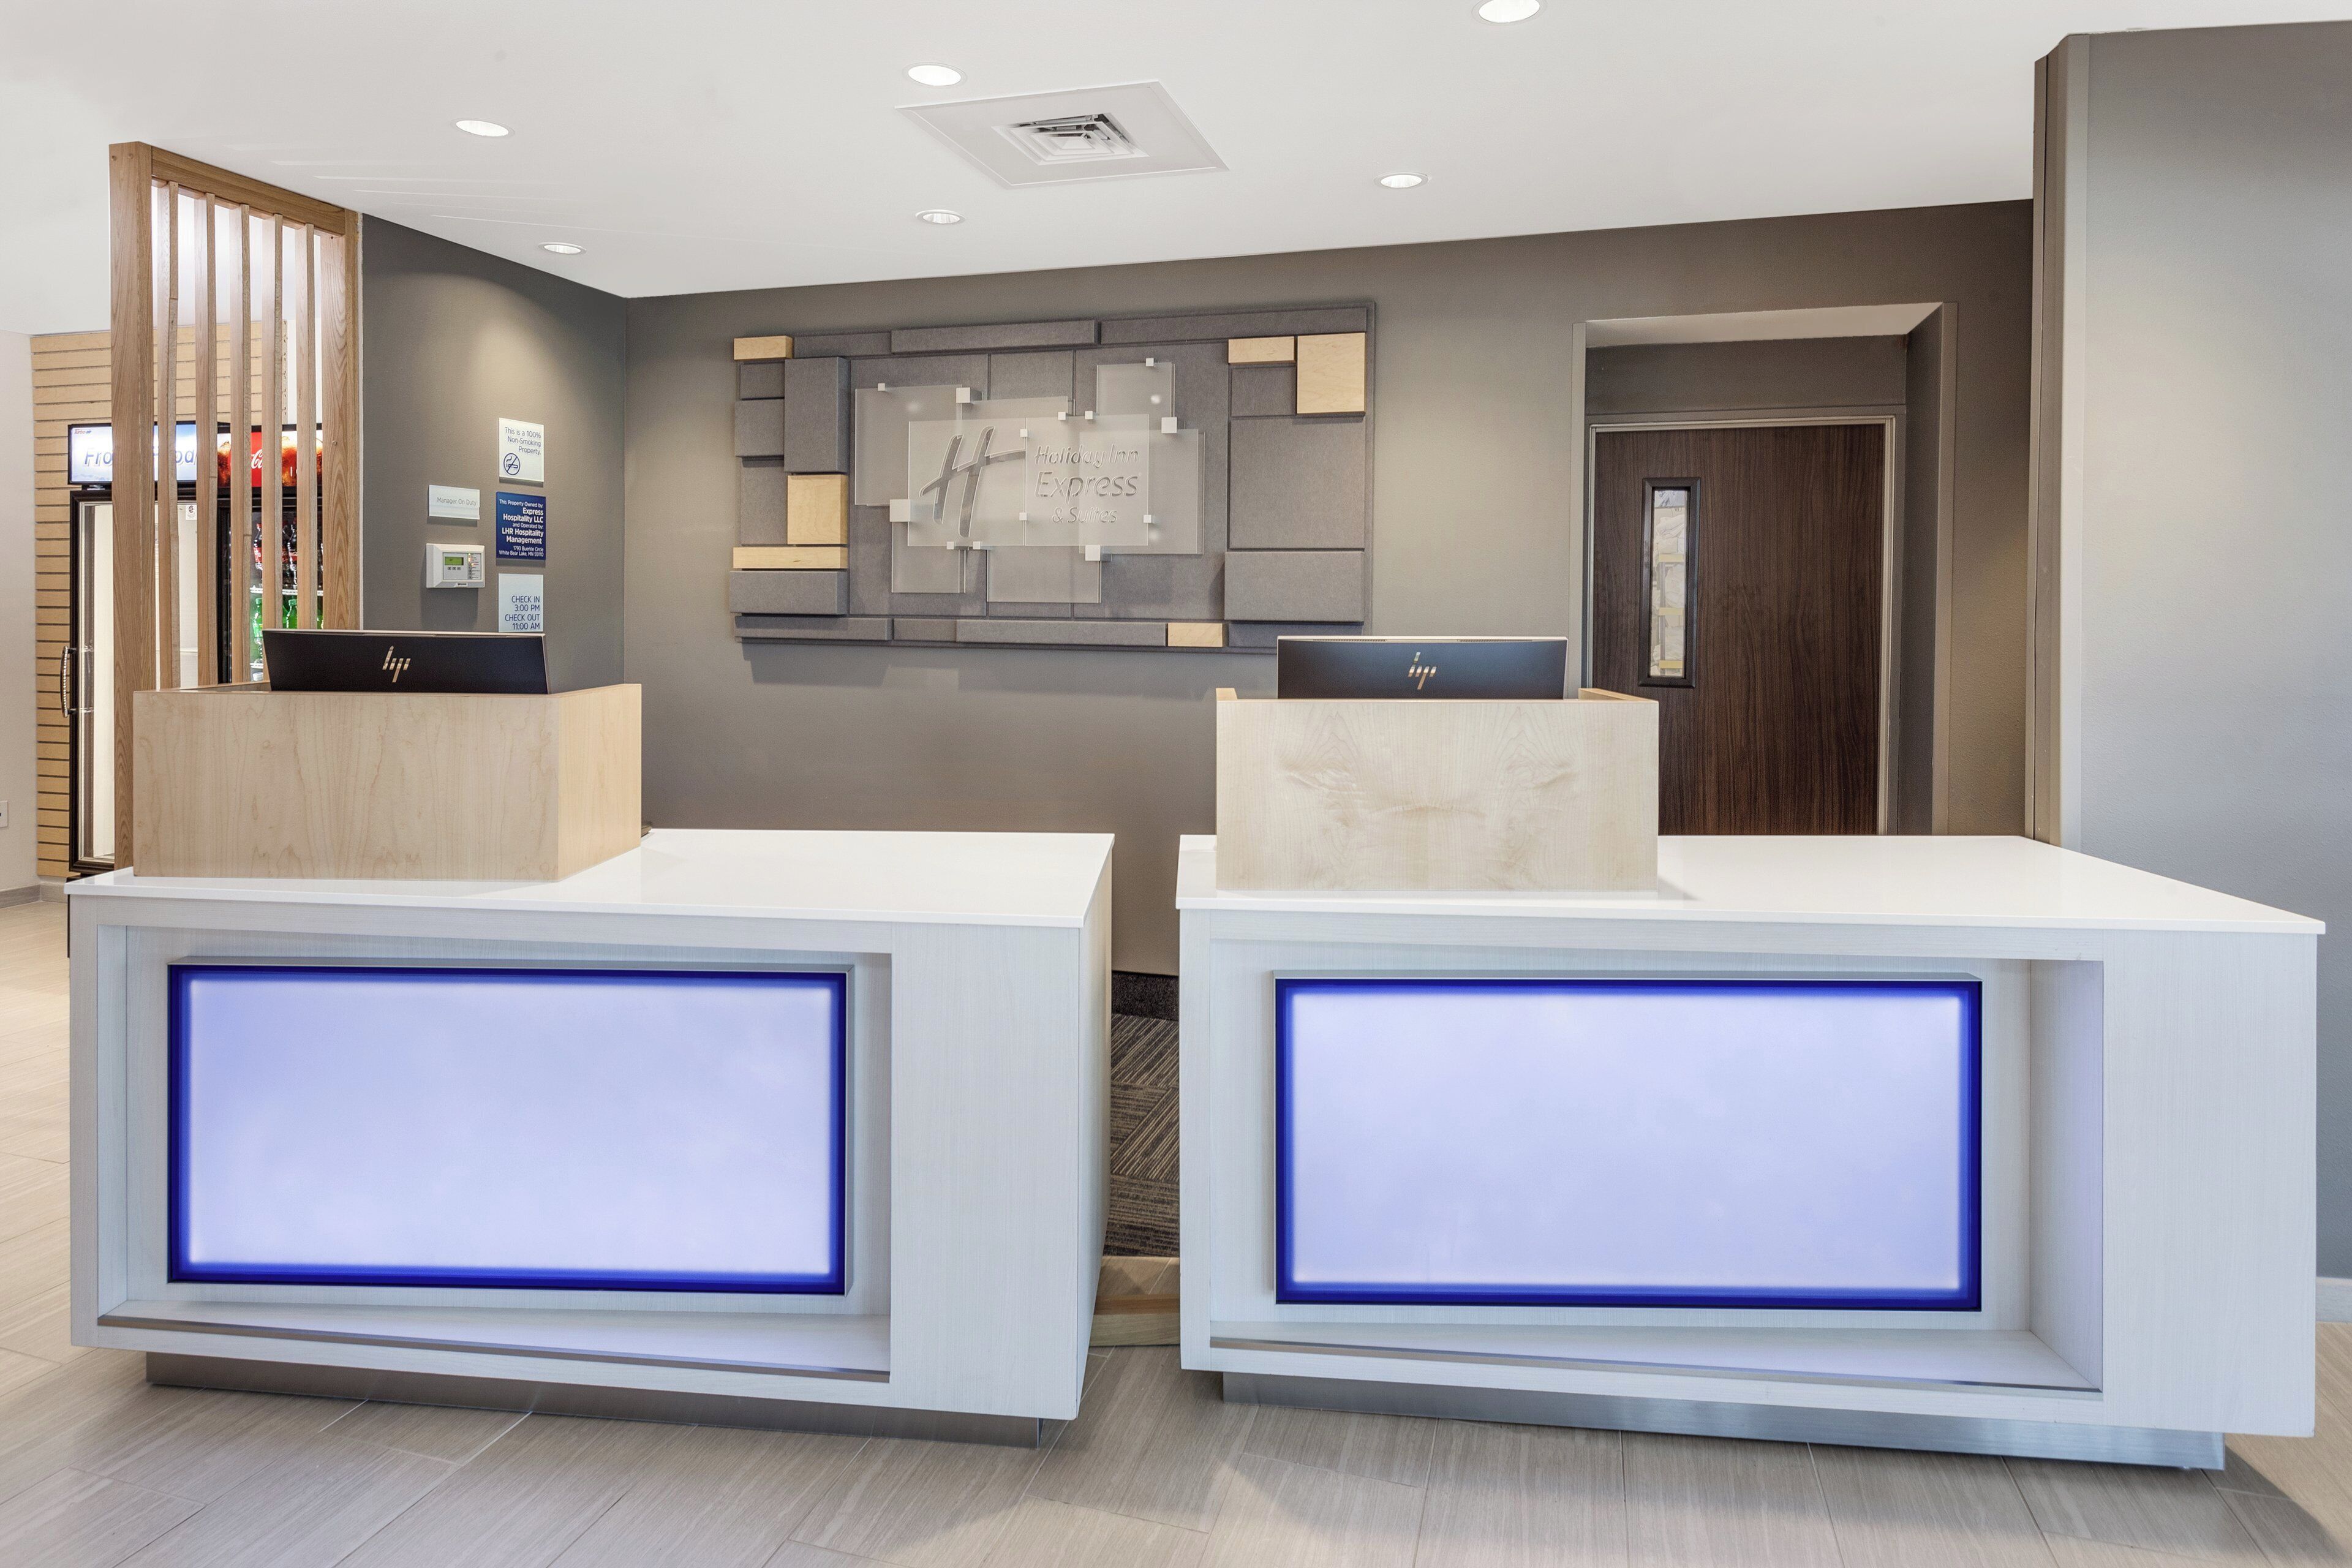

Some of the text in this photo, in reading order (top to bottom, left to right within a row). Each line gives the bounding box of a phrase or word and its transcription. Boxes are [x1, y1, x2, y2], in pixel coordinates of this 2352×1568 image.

[507, 436, 541, 447] Non-Smoking
[518, 446, 541, 455] Property.
[1035, 444, 1139, 469] Holiday Inn
[1035, 471, 1138, 504] Express
[503, 513, 533, 522] Hospitality
[1052, 507, 1117, 523] & Suites
[514, 528, 544, 537] Hospitality
[506, 535, 543, 544] Management
[382, 645, 411, 683] hp
[1408, 652, 1437, 690] hp
